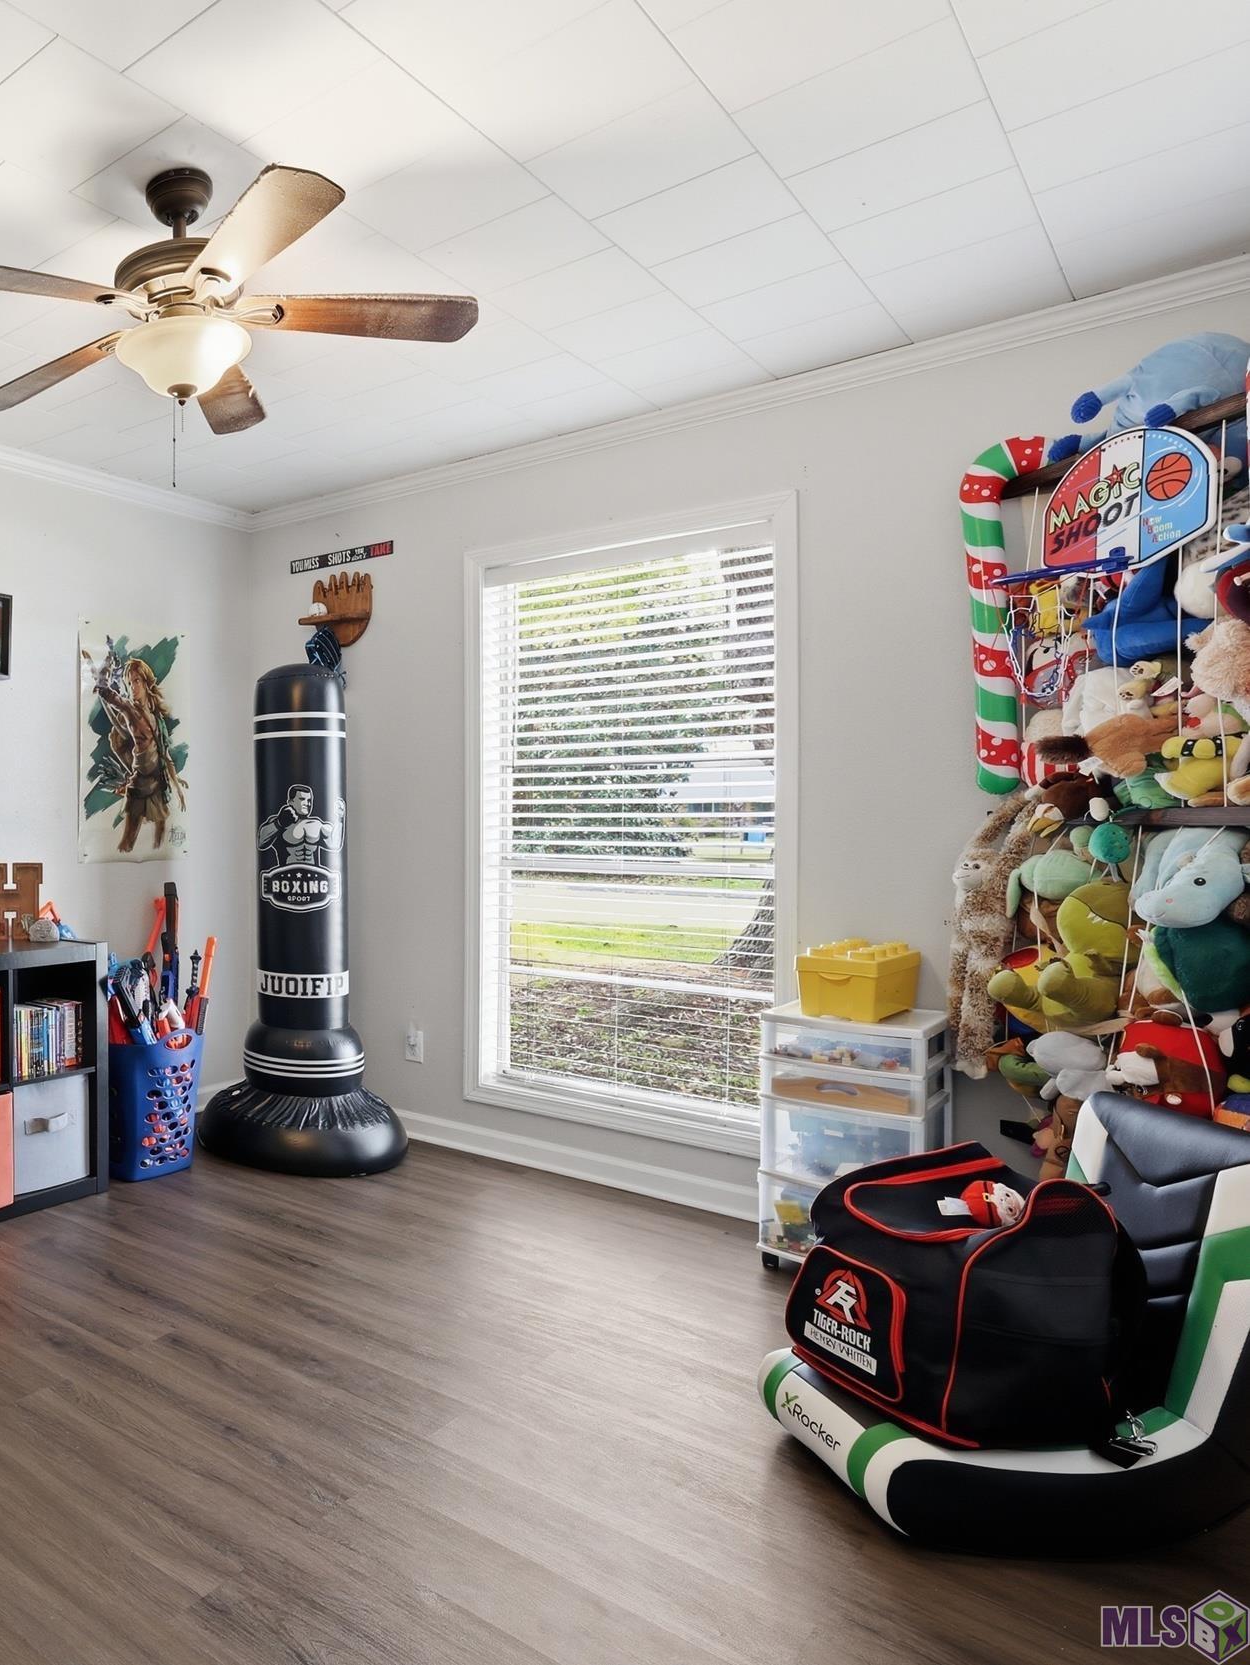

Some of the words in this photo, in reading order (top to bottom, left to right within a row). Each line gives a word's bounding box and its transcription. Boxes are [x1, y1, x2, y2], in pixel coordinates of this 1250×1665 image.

[1049, 461, 1142, 535] MAGIC
[1050, 490, 1140, 555] SHOOT
[303, 556, 319, 571] MISS
[328, 550, 351, 566] SHOTS
[370, 542, 392, 557] TAKE
[272, 880, 329, 894] BOXING
[813, 1308, 872, 1352] TIGER-ROCK
